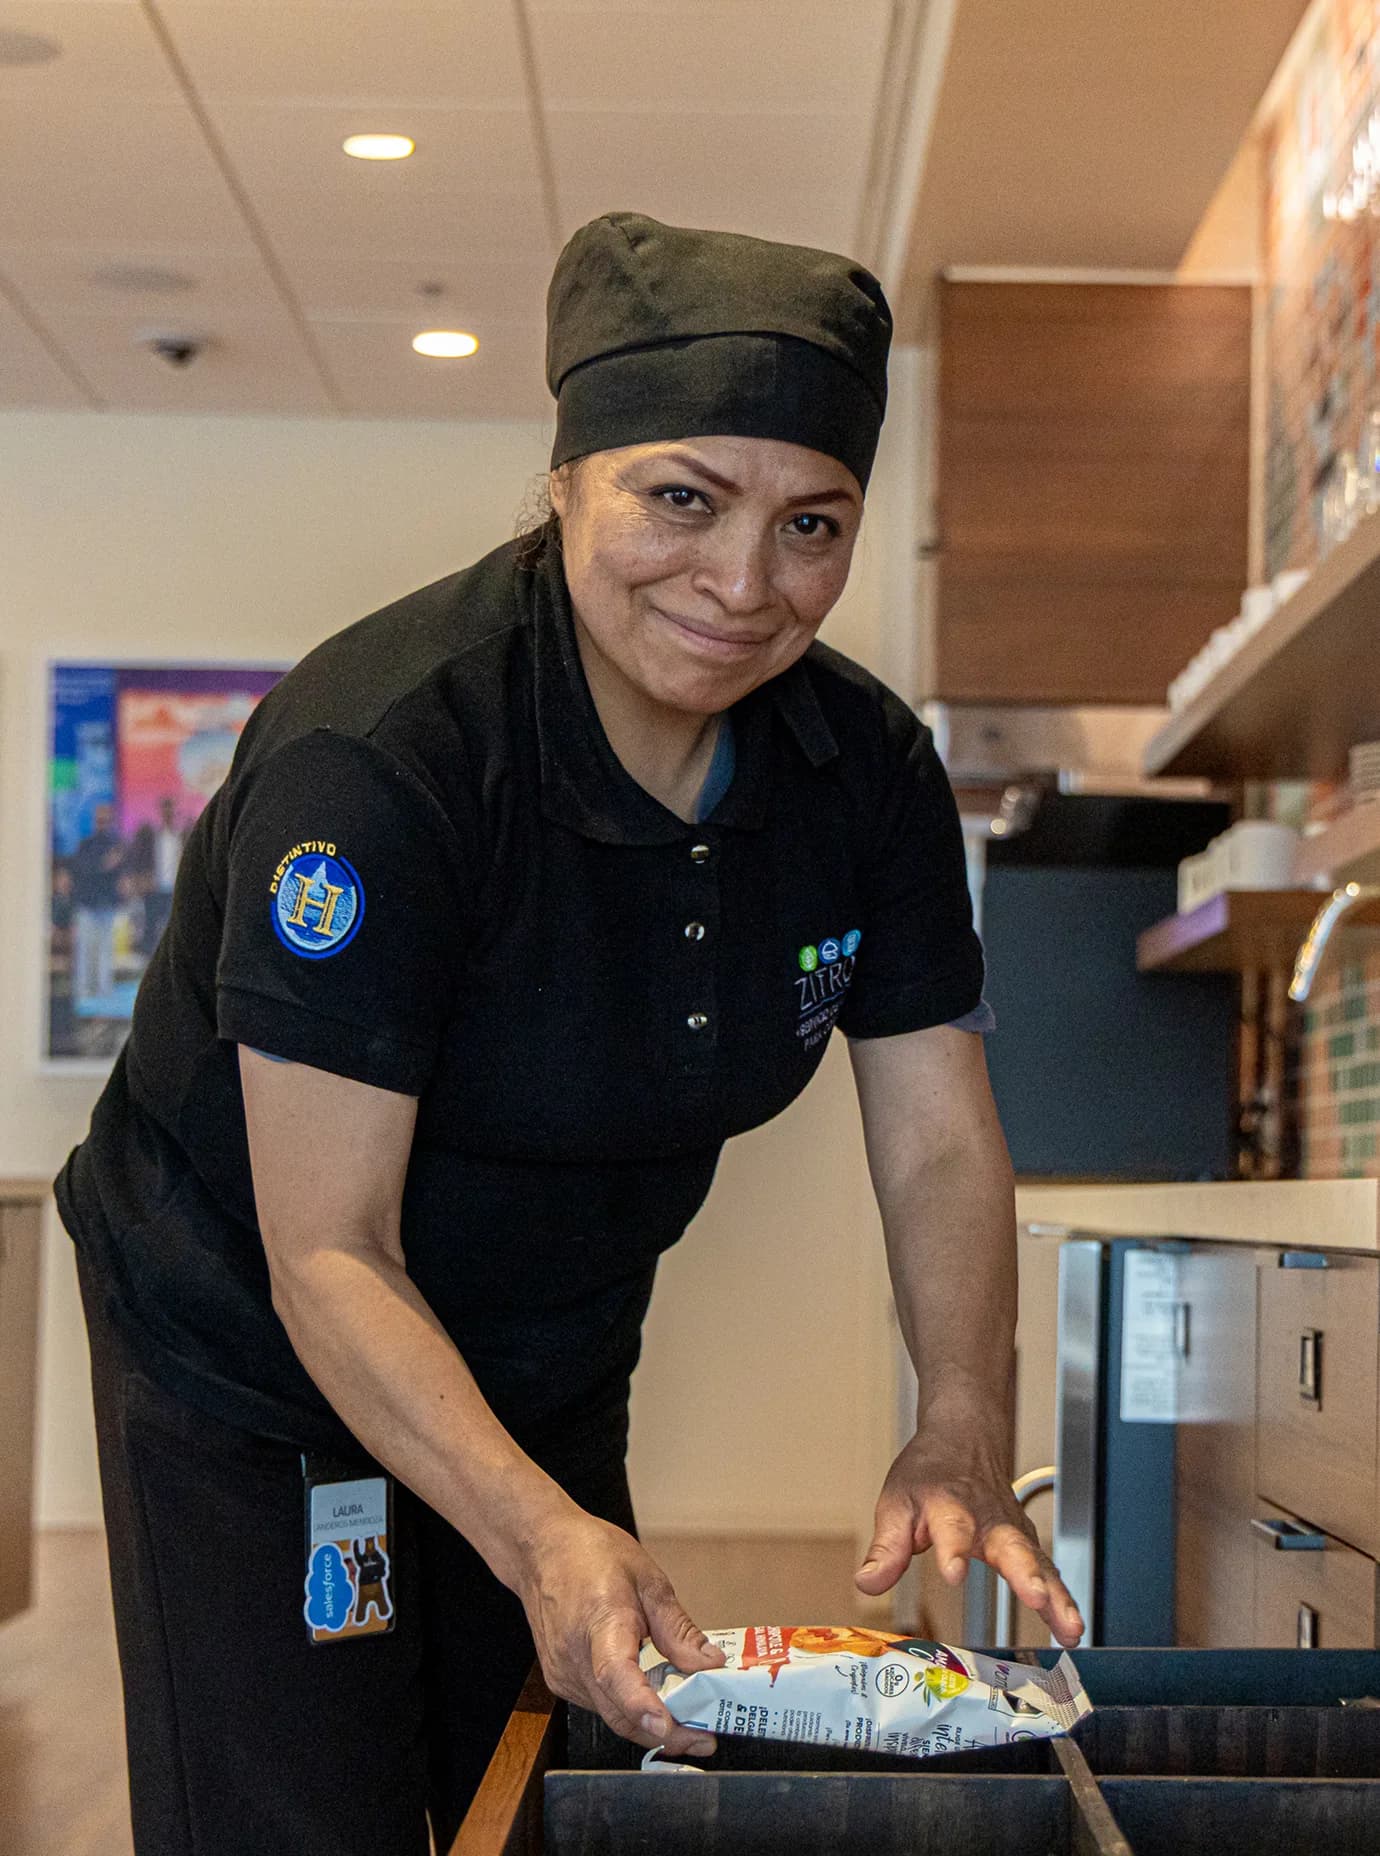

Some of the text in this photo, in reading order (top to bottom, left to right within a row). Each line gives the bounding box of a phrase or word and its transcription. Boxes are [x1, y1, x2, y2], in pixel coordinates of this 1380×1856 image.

[269, 841, 337, 894] DISTINTIVO
[288, 872, 344, 937] H
[332, 1504, 364, 1518] LAURA
[322, 1553, 335, 1618] salesforce
[737, 1704, 747, 1713] &
